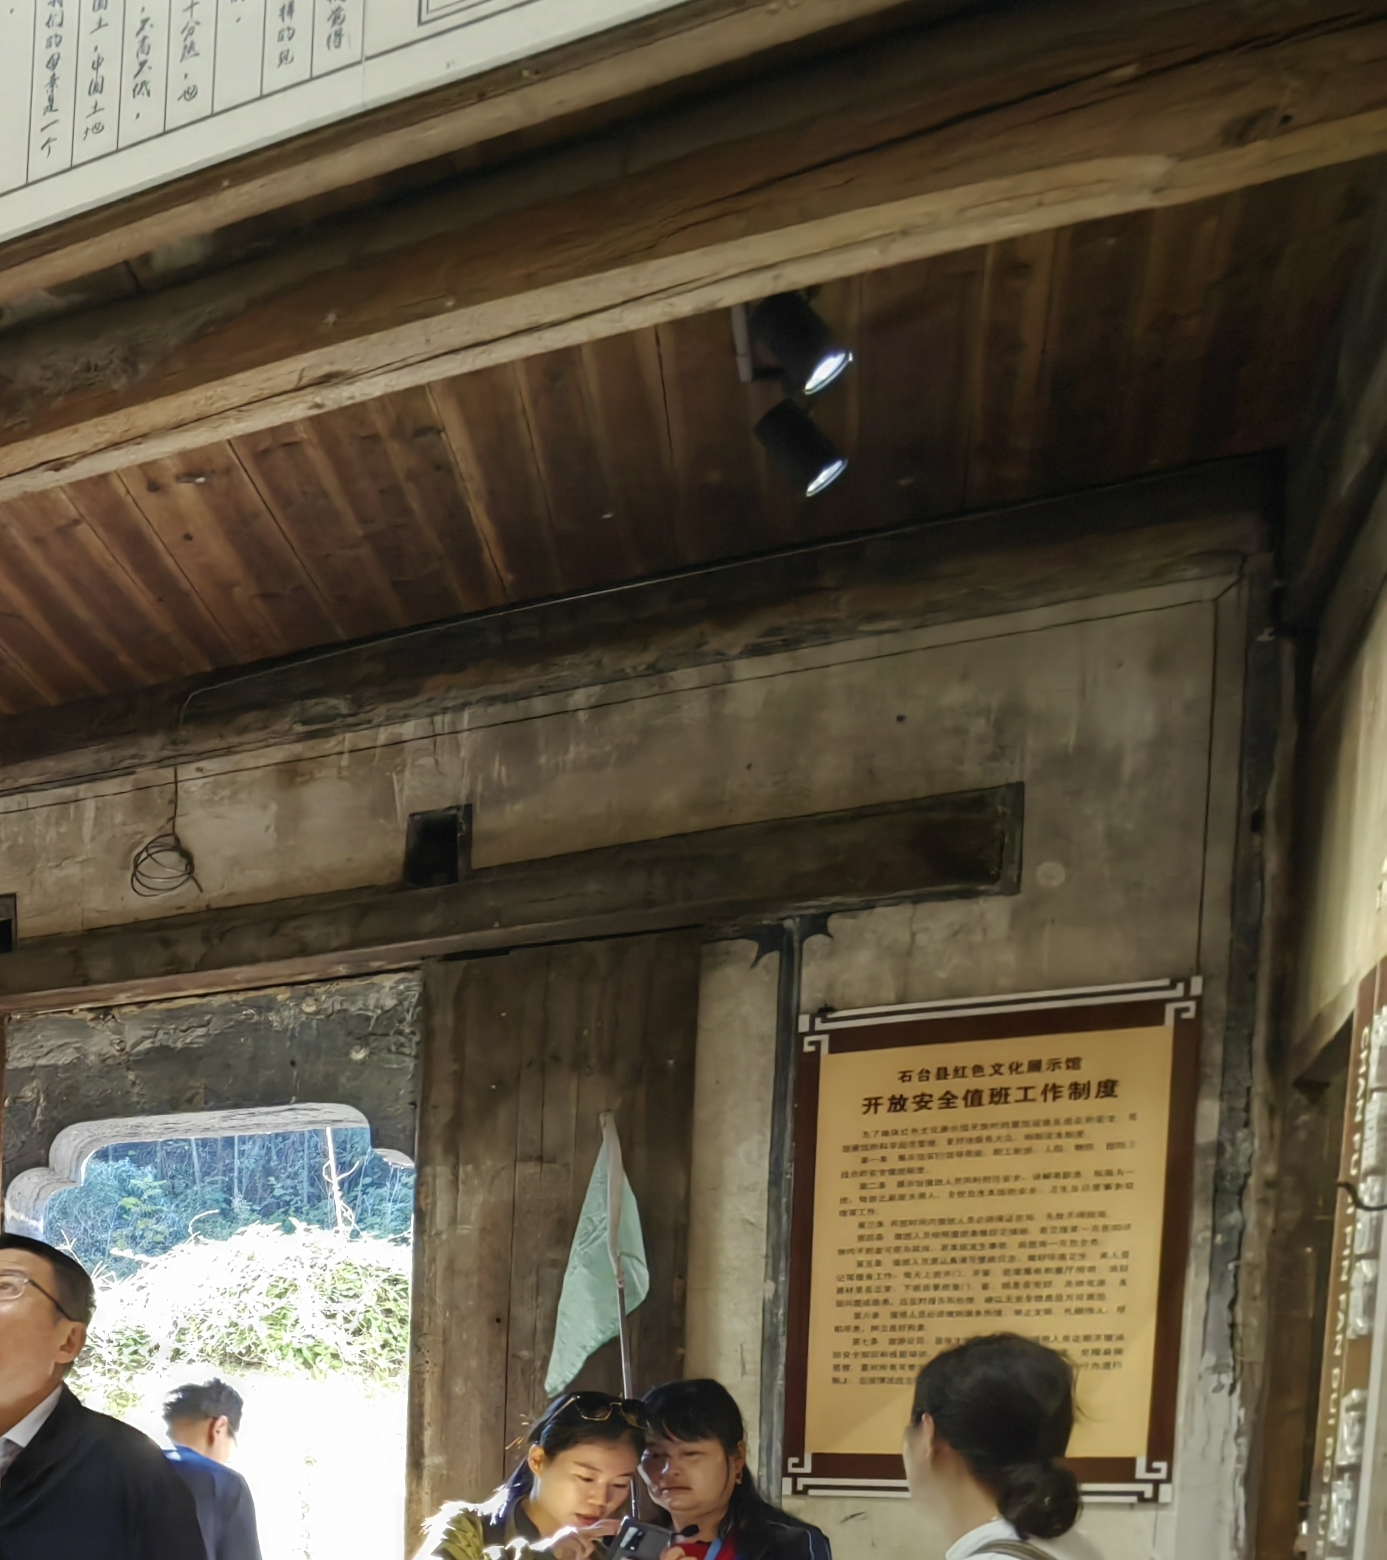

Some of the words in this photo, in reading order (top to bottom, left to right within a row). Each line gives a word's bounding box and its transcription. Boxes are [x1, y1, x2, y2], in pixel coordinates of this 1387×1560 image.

[897, 1056, 1084, 1085] 石台县红色文化展示馆
[861, 1078, 1120, 1117] 开放安全值班工作制度
